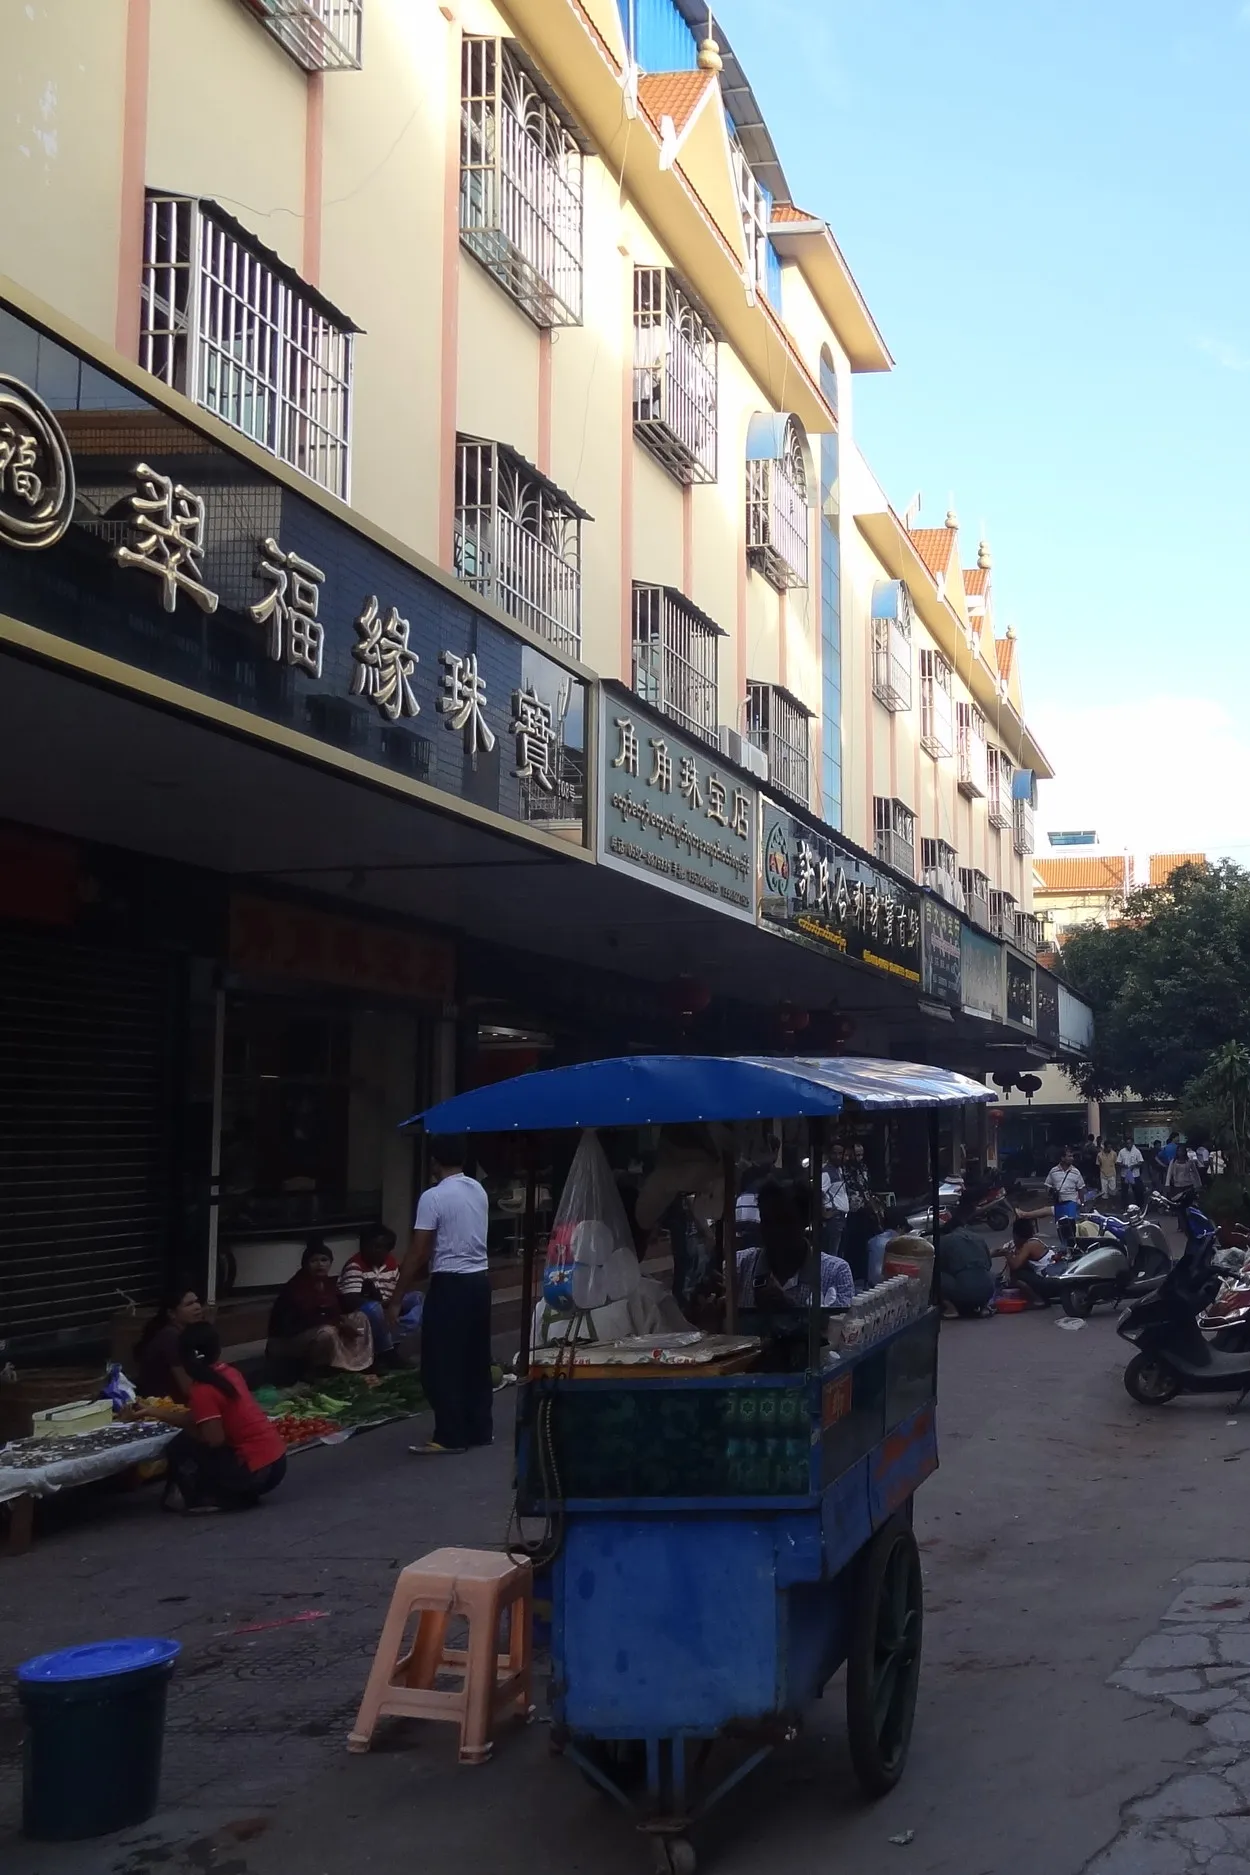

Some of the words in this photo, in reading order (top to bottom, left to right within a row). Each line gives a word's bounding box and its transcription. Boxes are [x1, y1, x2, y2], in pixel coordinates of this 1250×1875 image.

[0, 423, 42, 507] 福
[613, 716, 751, 841] 角角珠宝店
